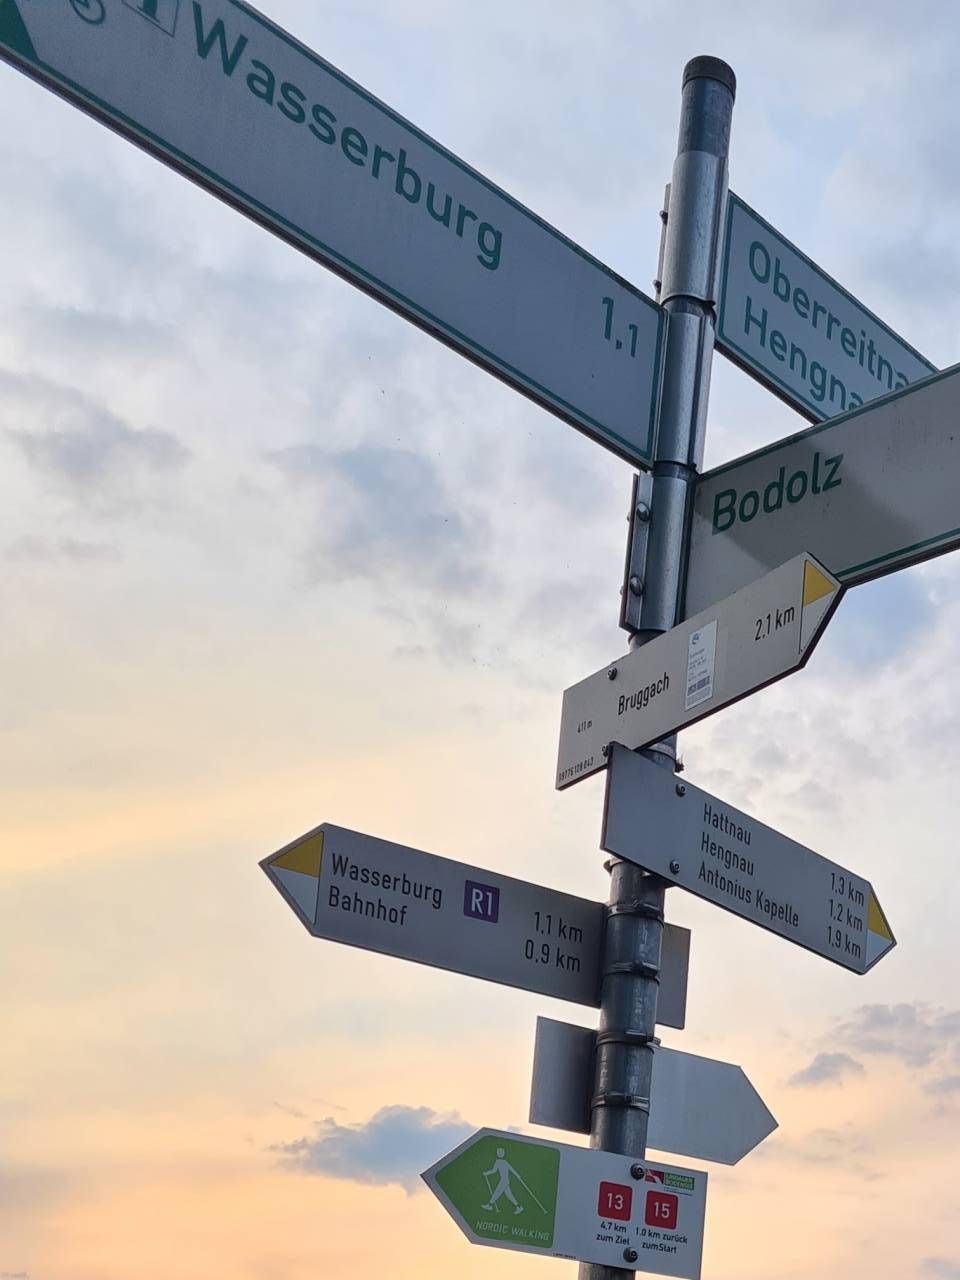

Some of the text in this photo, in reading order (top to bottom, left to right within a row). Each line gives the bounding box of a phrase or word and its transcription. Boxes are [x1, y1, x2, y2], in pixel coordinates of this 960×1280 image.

[193, 0, 502, 271] Wasserburg
[711, 452, 844, 536] Bodolz
[775, 605, 796, 629] km
[618, 671, 671, 716] Bruggach
[701, 831, 754, 877] Hengnau
[847, 908, 863, 932] km
[703, 802, 752, 846] Hattnau
[848, 880, 865, 905] km
[328, 885, 407, 926] Bahnhof
[556, 946, 581, 973] km
[331, 852, 443, 909] Wasserburg
[471, 888, 493, 917] R1
[559, 918, 583, 944] km
[698, 861, 752, 904] Antonius
[756, 889, 800, 928] Kapelle
[845, 934, 861, 959] km
[476, 1220, 550, 1241] NORDIC WALKING
[607, 1192, 671, 1219] 13 15
[614, 1223, 627, 1233] km
[648, 1228, 661, 1239] km
[662, 1231, 688, 1244] zurück
[596, 1234, 630, 1246] zum Ziel
